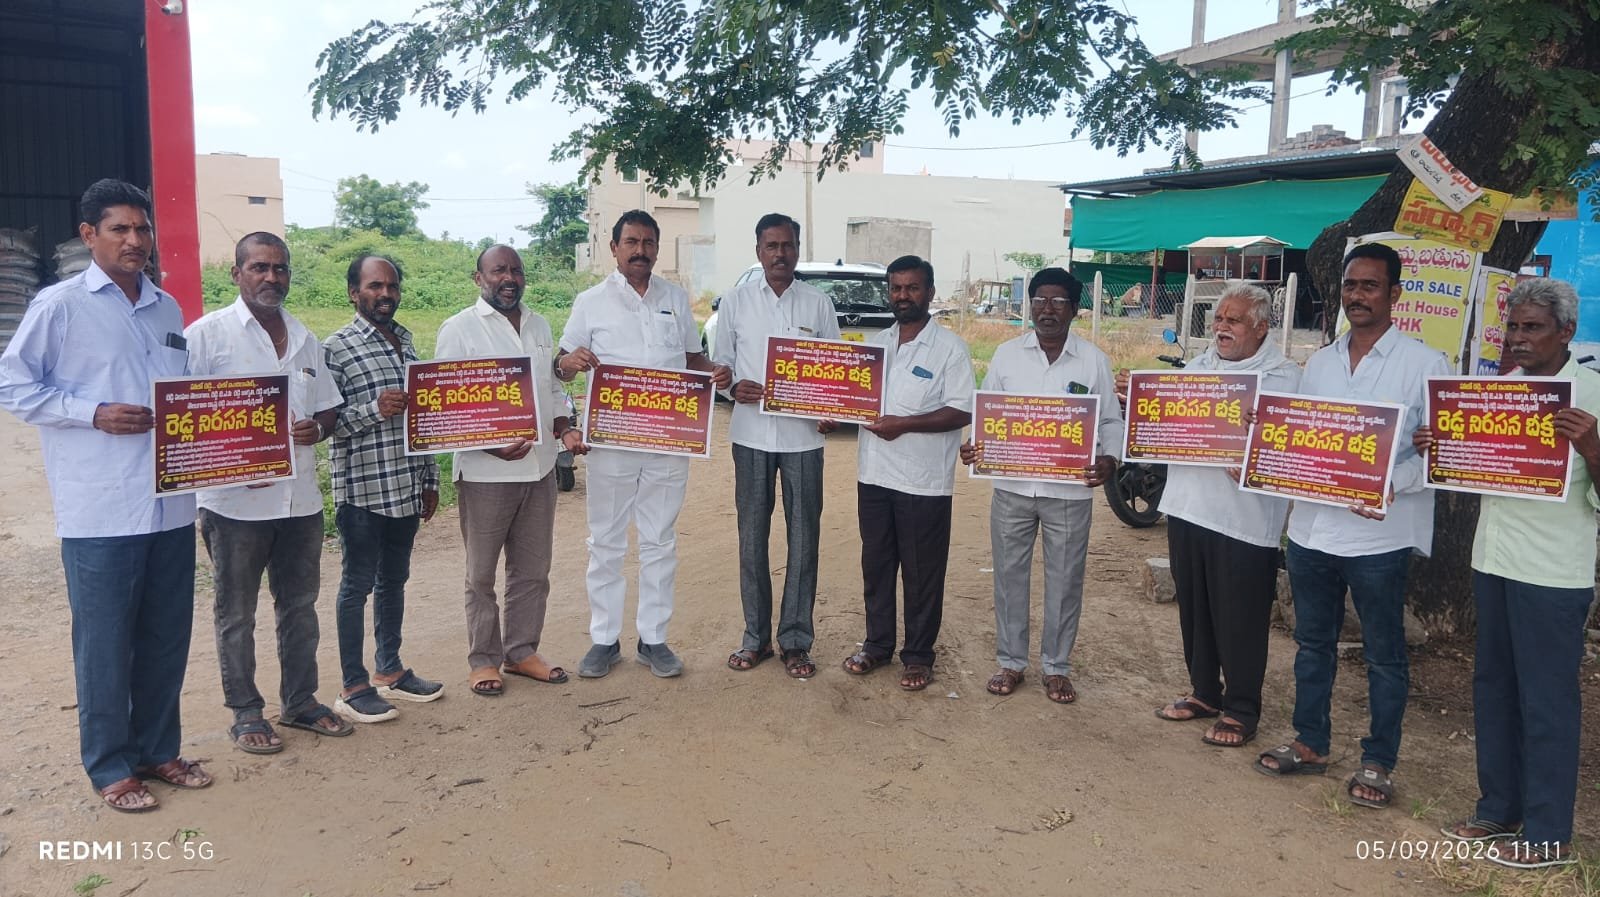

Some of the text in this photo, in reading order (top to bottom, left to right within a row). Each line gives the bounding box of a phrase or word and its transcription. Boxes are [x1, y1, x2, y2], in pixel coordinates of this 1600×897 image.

[1398, 246, 1471, 273] మ్మబడును
[1428, 281, 1462, 297] SALE
[1415, 300, 1458, 317] House
[802, 363, 845, 380] నిరసన
[446, 385, 492, 404] నిరసన
[627, 392, 671, 410] నిరసన
[1164, 399, 1211, 417] నిరసన
[199, 409, 247, 432] నిరసన
[1011, 420, 1057, 437] నిరసన
[1469, 412, 1521, 435] నిరసన
[1292, 429, 1344, 451] నిరసన
